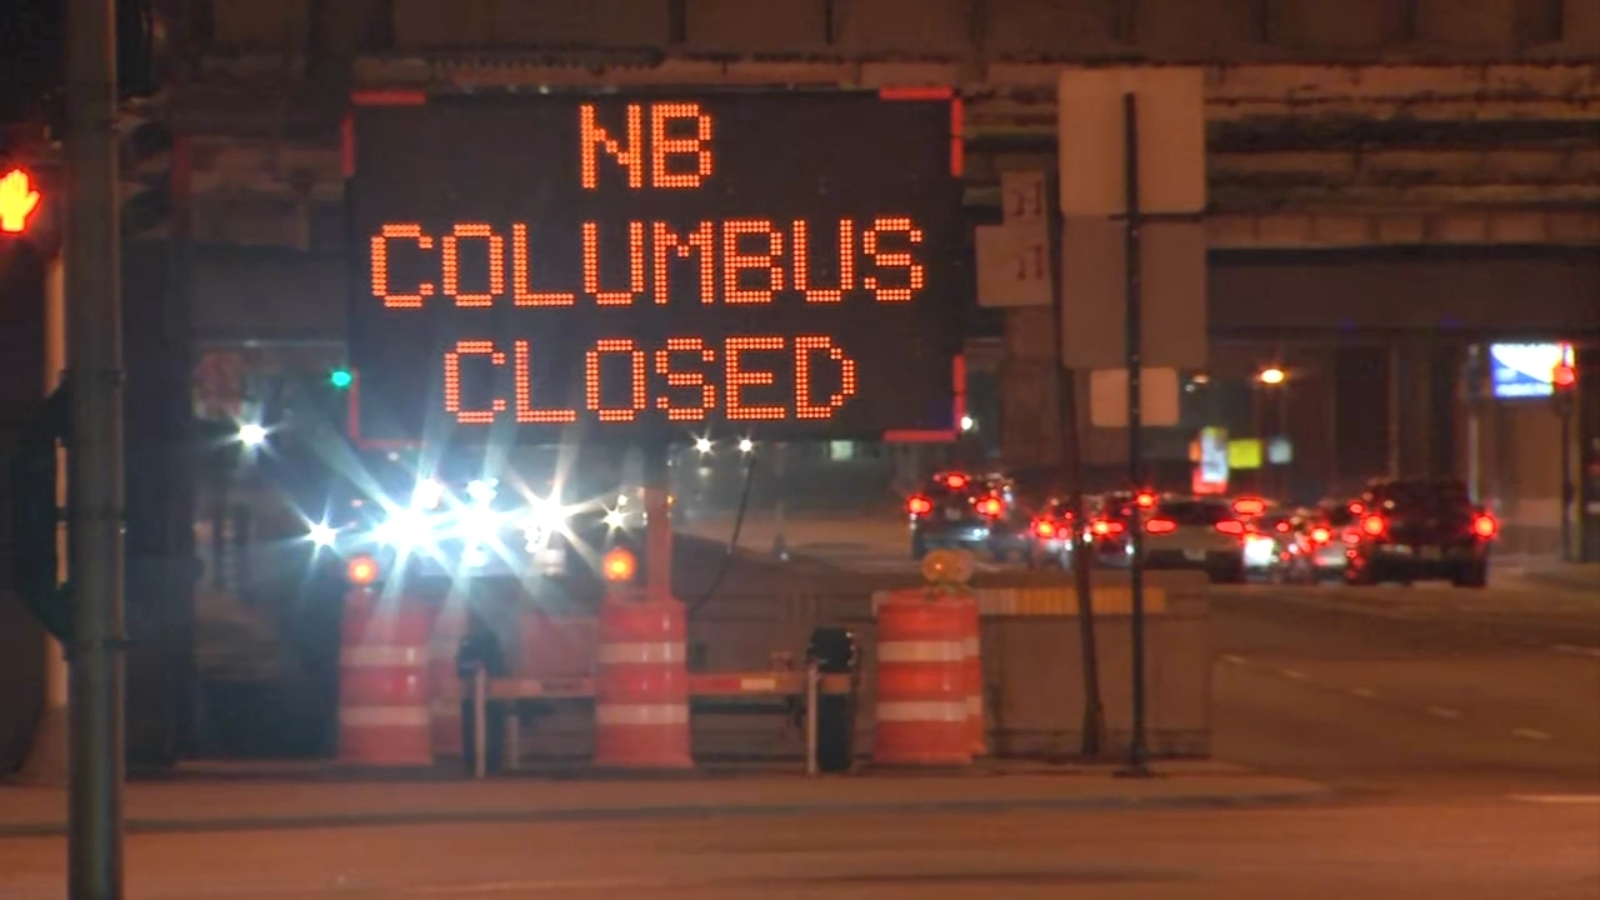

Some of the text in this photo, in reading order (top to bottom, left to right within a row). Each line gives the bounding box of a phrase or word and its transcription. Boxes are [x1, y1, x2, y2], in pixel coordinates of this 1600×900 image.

[579, 103, 713, 189] NB
[370, 218, 924, 308] COLUMBUS
[444, 336, 855, 424] CLOSED
